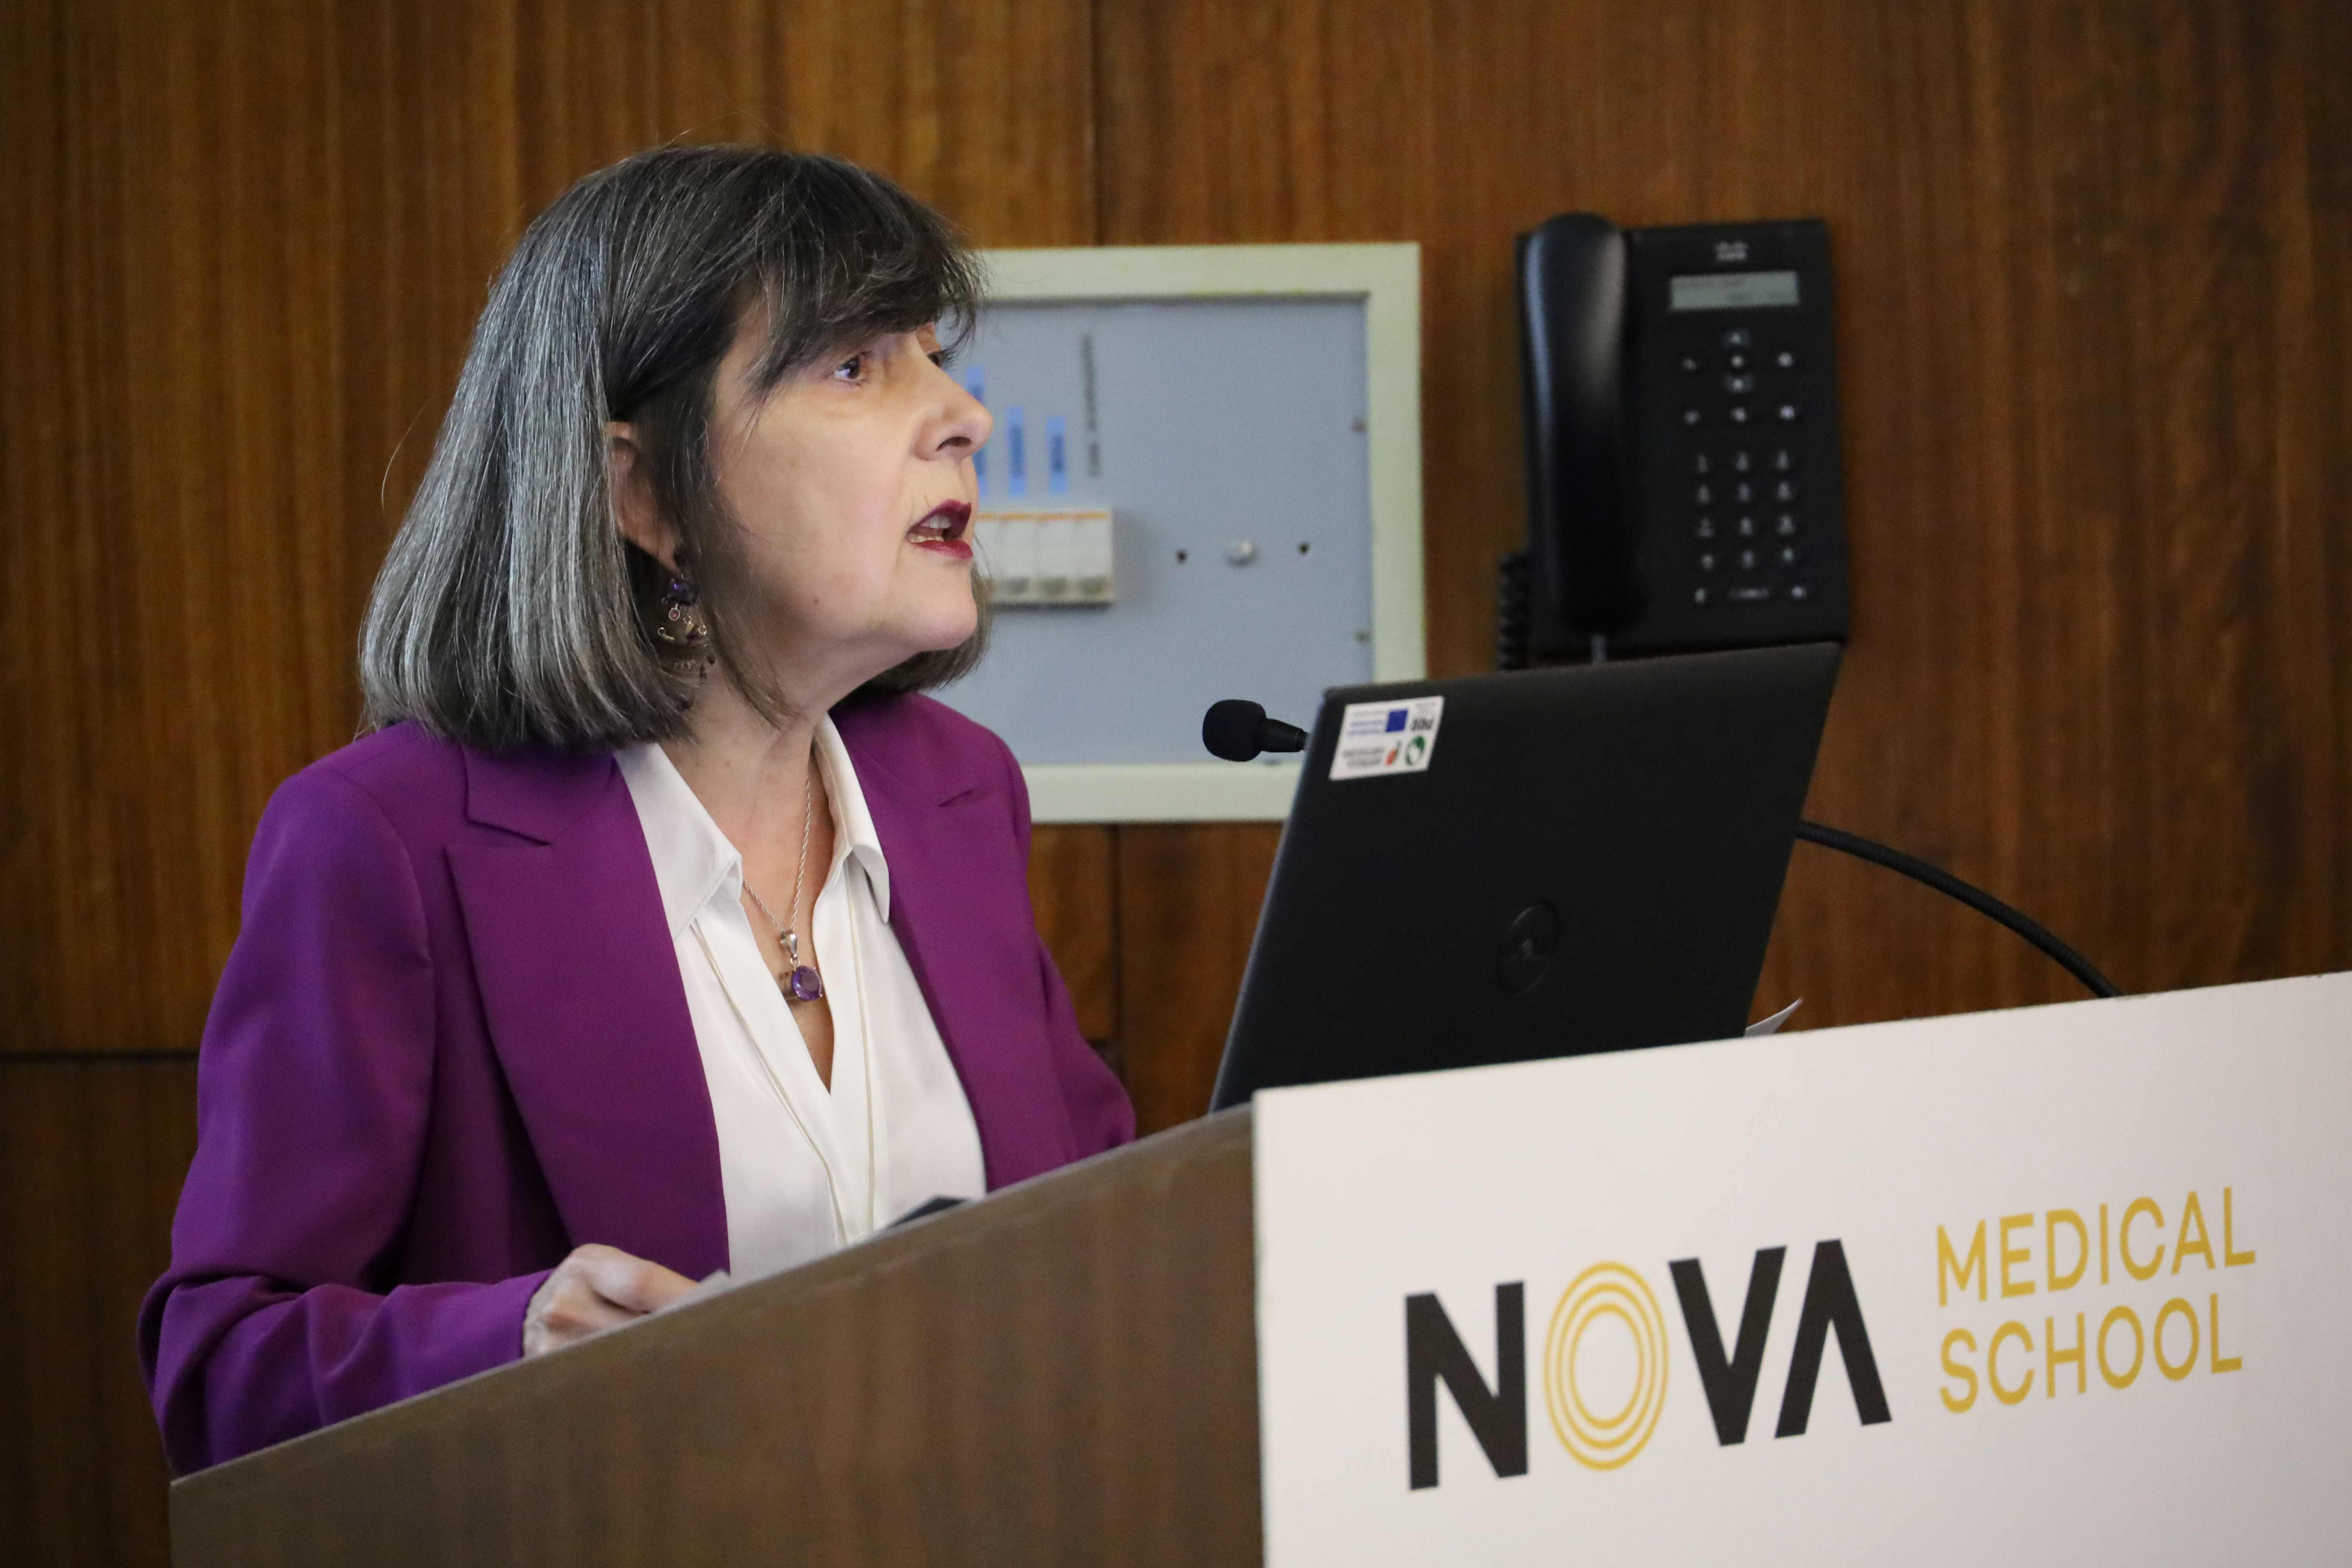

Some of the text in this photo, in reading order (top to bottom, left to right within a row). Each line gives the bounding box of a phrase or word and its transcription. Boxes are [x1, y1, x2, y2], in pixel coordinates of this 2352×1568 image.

[1937, 1186, 2256, 1307] MEDICAL
[1406, 1239, 1892, 1490] NOVA
[1939, 1293, 2243, 1414] SCHOOL
